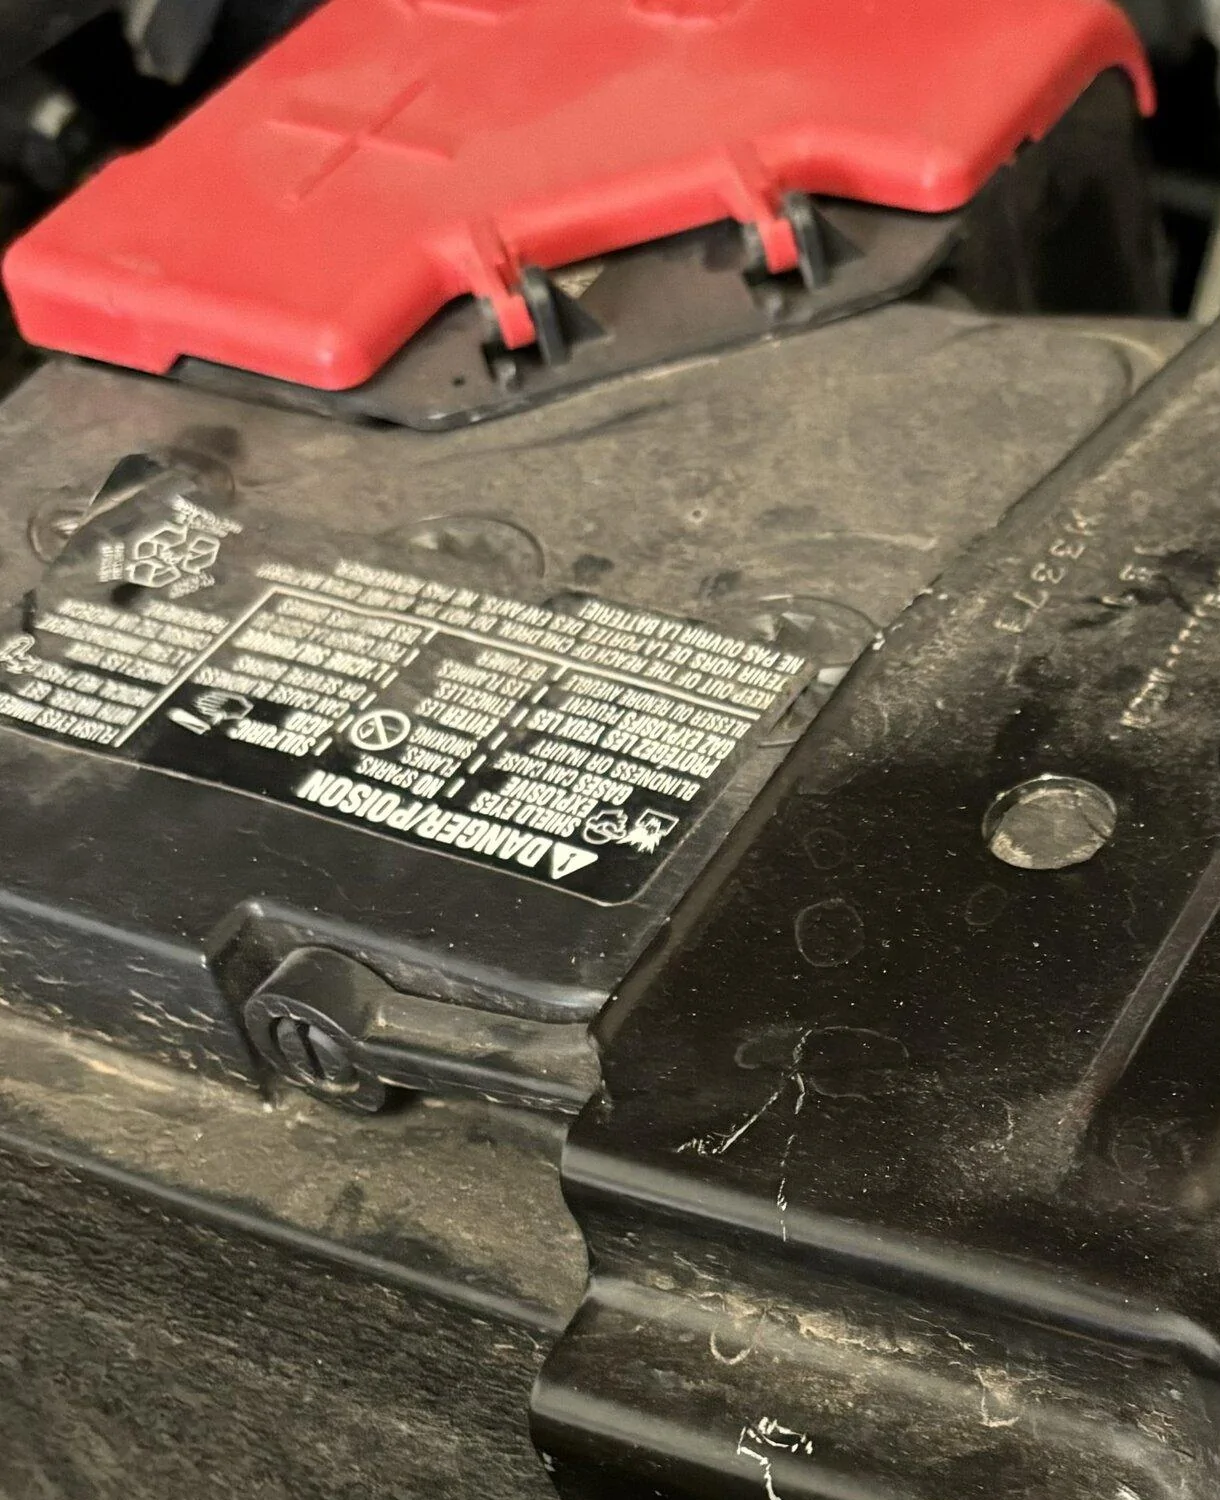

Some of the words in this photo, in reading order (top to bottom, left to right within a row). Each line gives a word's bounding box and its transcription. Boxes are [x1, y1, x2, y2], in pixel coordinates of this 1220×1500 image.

[549, 615, 585, 635] DES
[578, 601, 660, 635] BATTERIE!
[657, 620, 683, 640] LA
[570, 643, 597, 660] OF
[644, 639, 669, 657] LA
[664, 644, 693, 664] DE
[679, 627, 744, 657] OUVRIR
[476, 651, 527, 675] FUMER
[593, 648, 648, 672] REACH
[690, 652, 740, 678] HORS
[741, 644, 780, 667] PAS
[775, 654, 804, 674] NE
[283, 667, 342, 694] SEVERE
[521, 662, 547, 681] DE
[643, 660, 677, 681] THE
[674, 671, 702, 689] OF
[737, 665, 788, 691] TENIR
[268, 684, 319, 709] CAUSE
[338, 682, 366, 701] OR
[500, 678, 531, 698] LES
[562, 674, 623, 701] AVEUGLE
[696, 677, 735, 699] OUT
[731, 688, 775, 709] KEEP
[314, 697, 349, 718] CAN
[414, 697, 446, 718] LES
[559, 696, 624, 724] PEUVENT
[618, 689, 674, 716] RENDRE
[668, 703, 694, 722] OU
[36, 708, 77, 732] EYES
[70, 720, 118, 743] FLUSH
[285, 711, 333, 737] ACID
[439, 705, 499, 740] ÉVITER
[527, 708, 564, 733] LES
[557, 716, 604, 744] YEUX
[618, 711, 704, 749] EXPLOSIFS
[689, 710, 750, 738] BLESSER
[229, 715, 315, 755] SULFURIC
[409, 726, 477, 758] SMOKING
[601, 728, 638, 753] LES
[697, 734, 735, 759] GAZ
[493, 751, 546, 777] CAUSE
[529, 739, 590, 766] INJURY
[585, 753, 614, 774] OR
[631, 738, 719, 777] PROTÉGEZ
[411, 774, 444, 798] NO
[542, 764, 578, 786] CAN
[610, 761, 699, 800] BLINDNESS
[500, 776, 597, 818] EXPLOSIVE
[572, 773, 632, 805] GASES
[470, 791, 521, 819] EYES
[299, 772, 550, 865] DANGER/POISON
[515, 804, 580, 836] SHIELD
